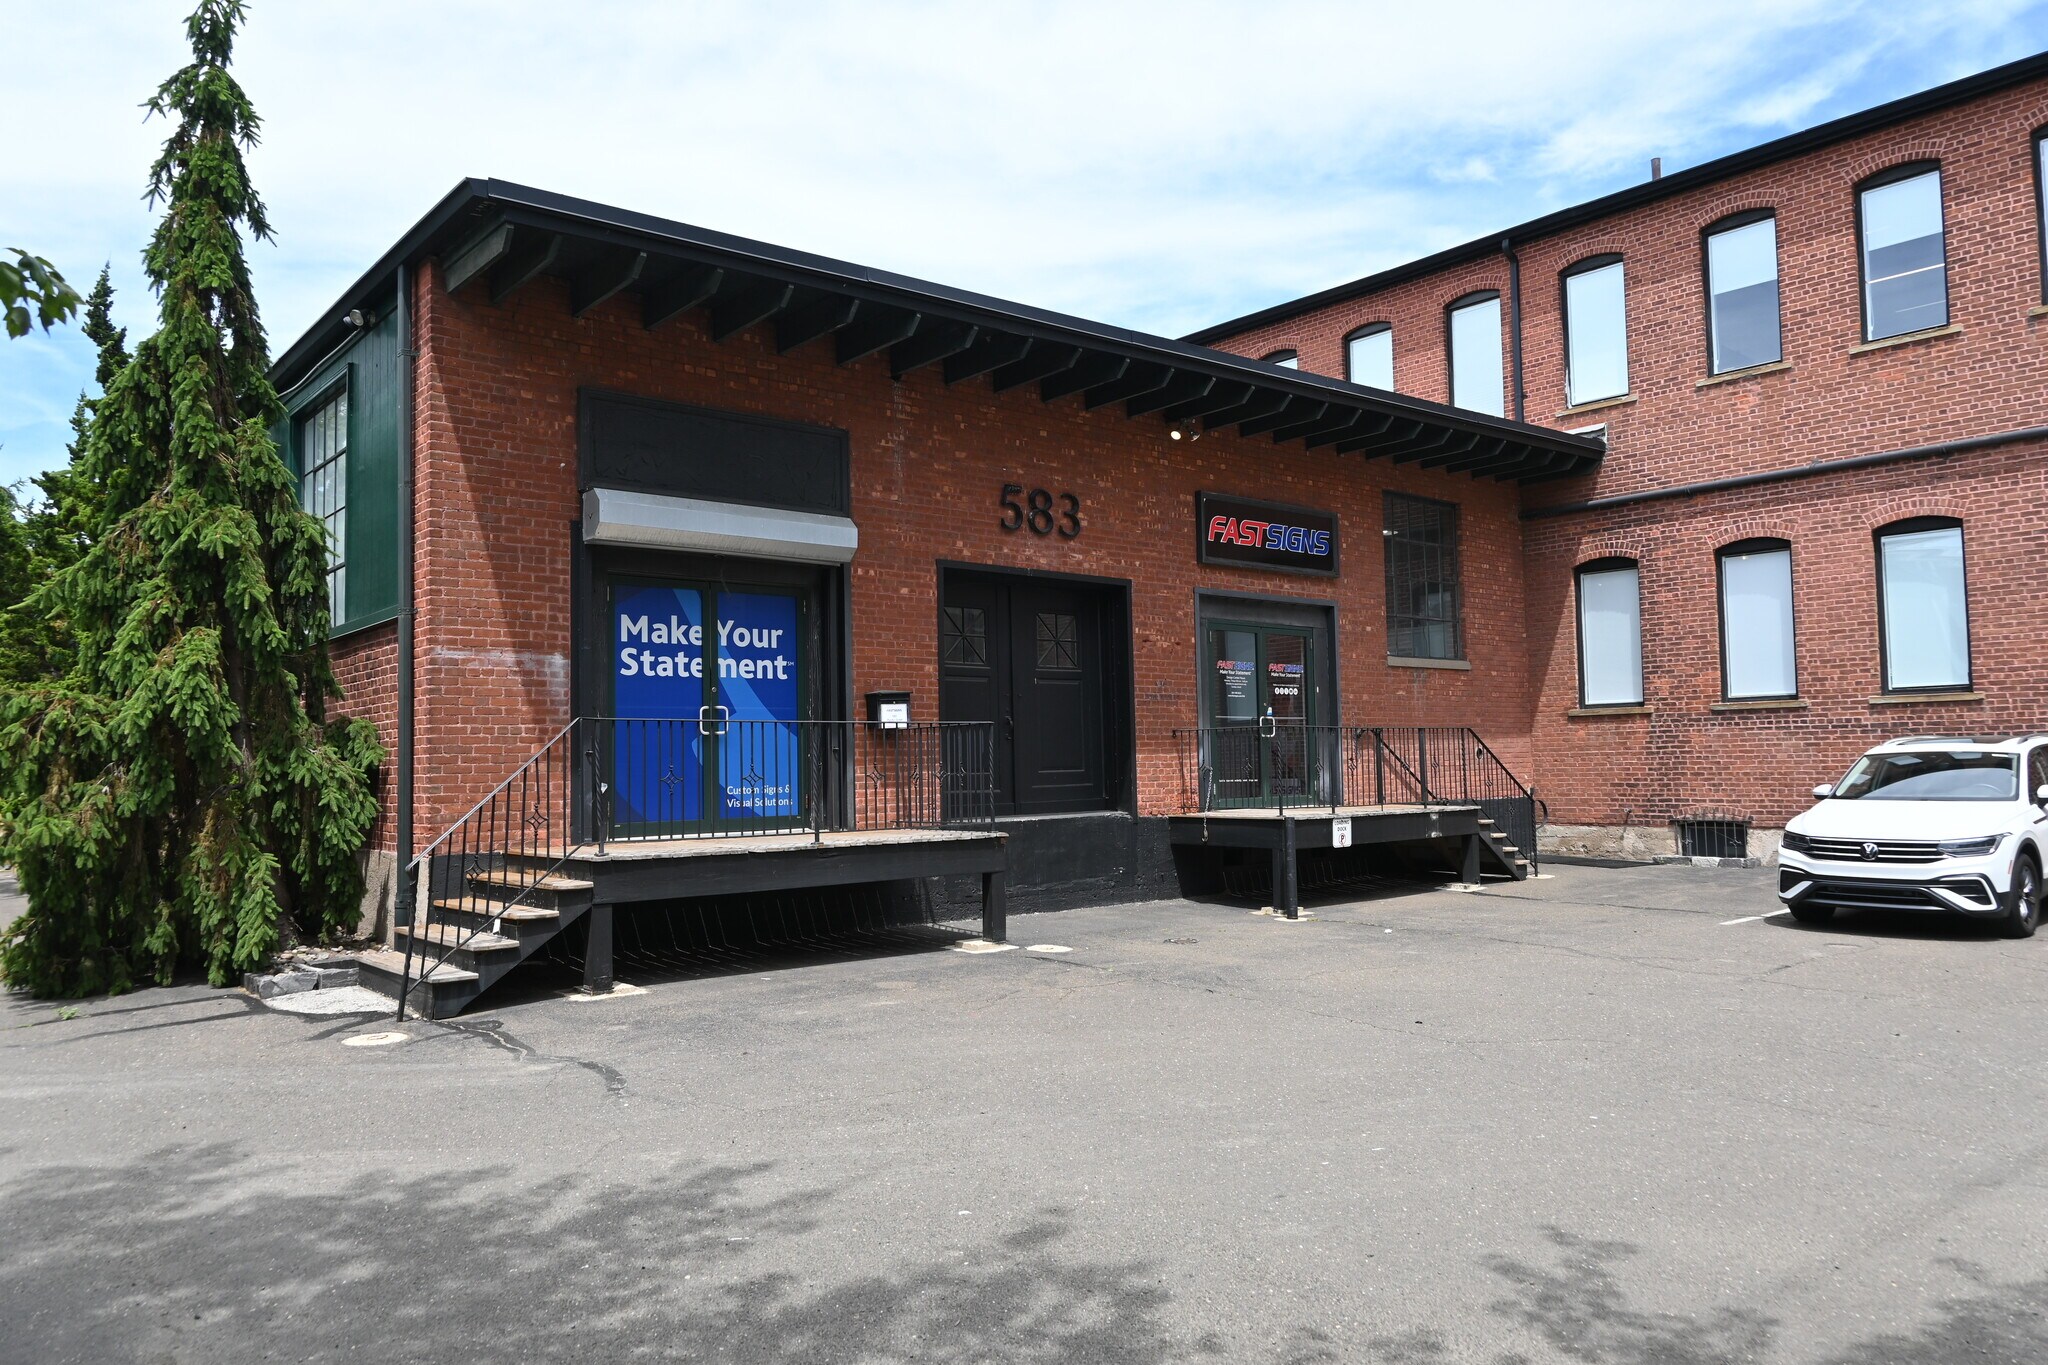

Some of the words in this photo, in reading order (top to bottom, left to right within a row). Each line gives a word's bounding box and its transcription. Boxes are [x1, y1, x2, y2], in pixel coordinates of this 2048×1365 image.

[1001, 484, 1080, 538] 583
[1208, 515, 1330, 556] FASTSIGNS
[620, 614, 702, 646] Make
[717, 619, 783, 649] Your
[727, 785, 759, 795] Custom
[754, 797, 793, 807] Soluton
